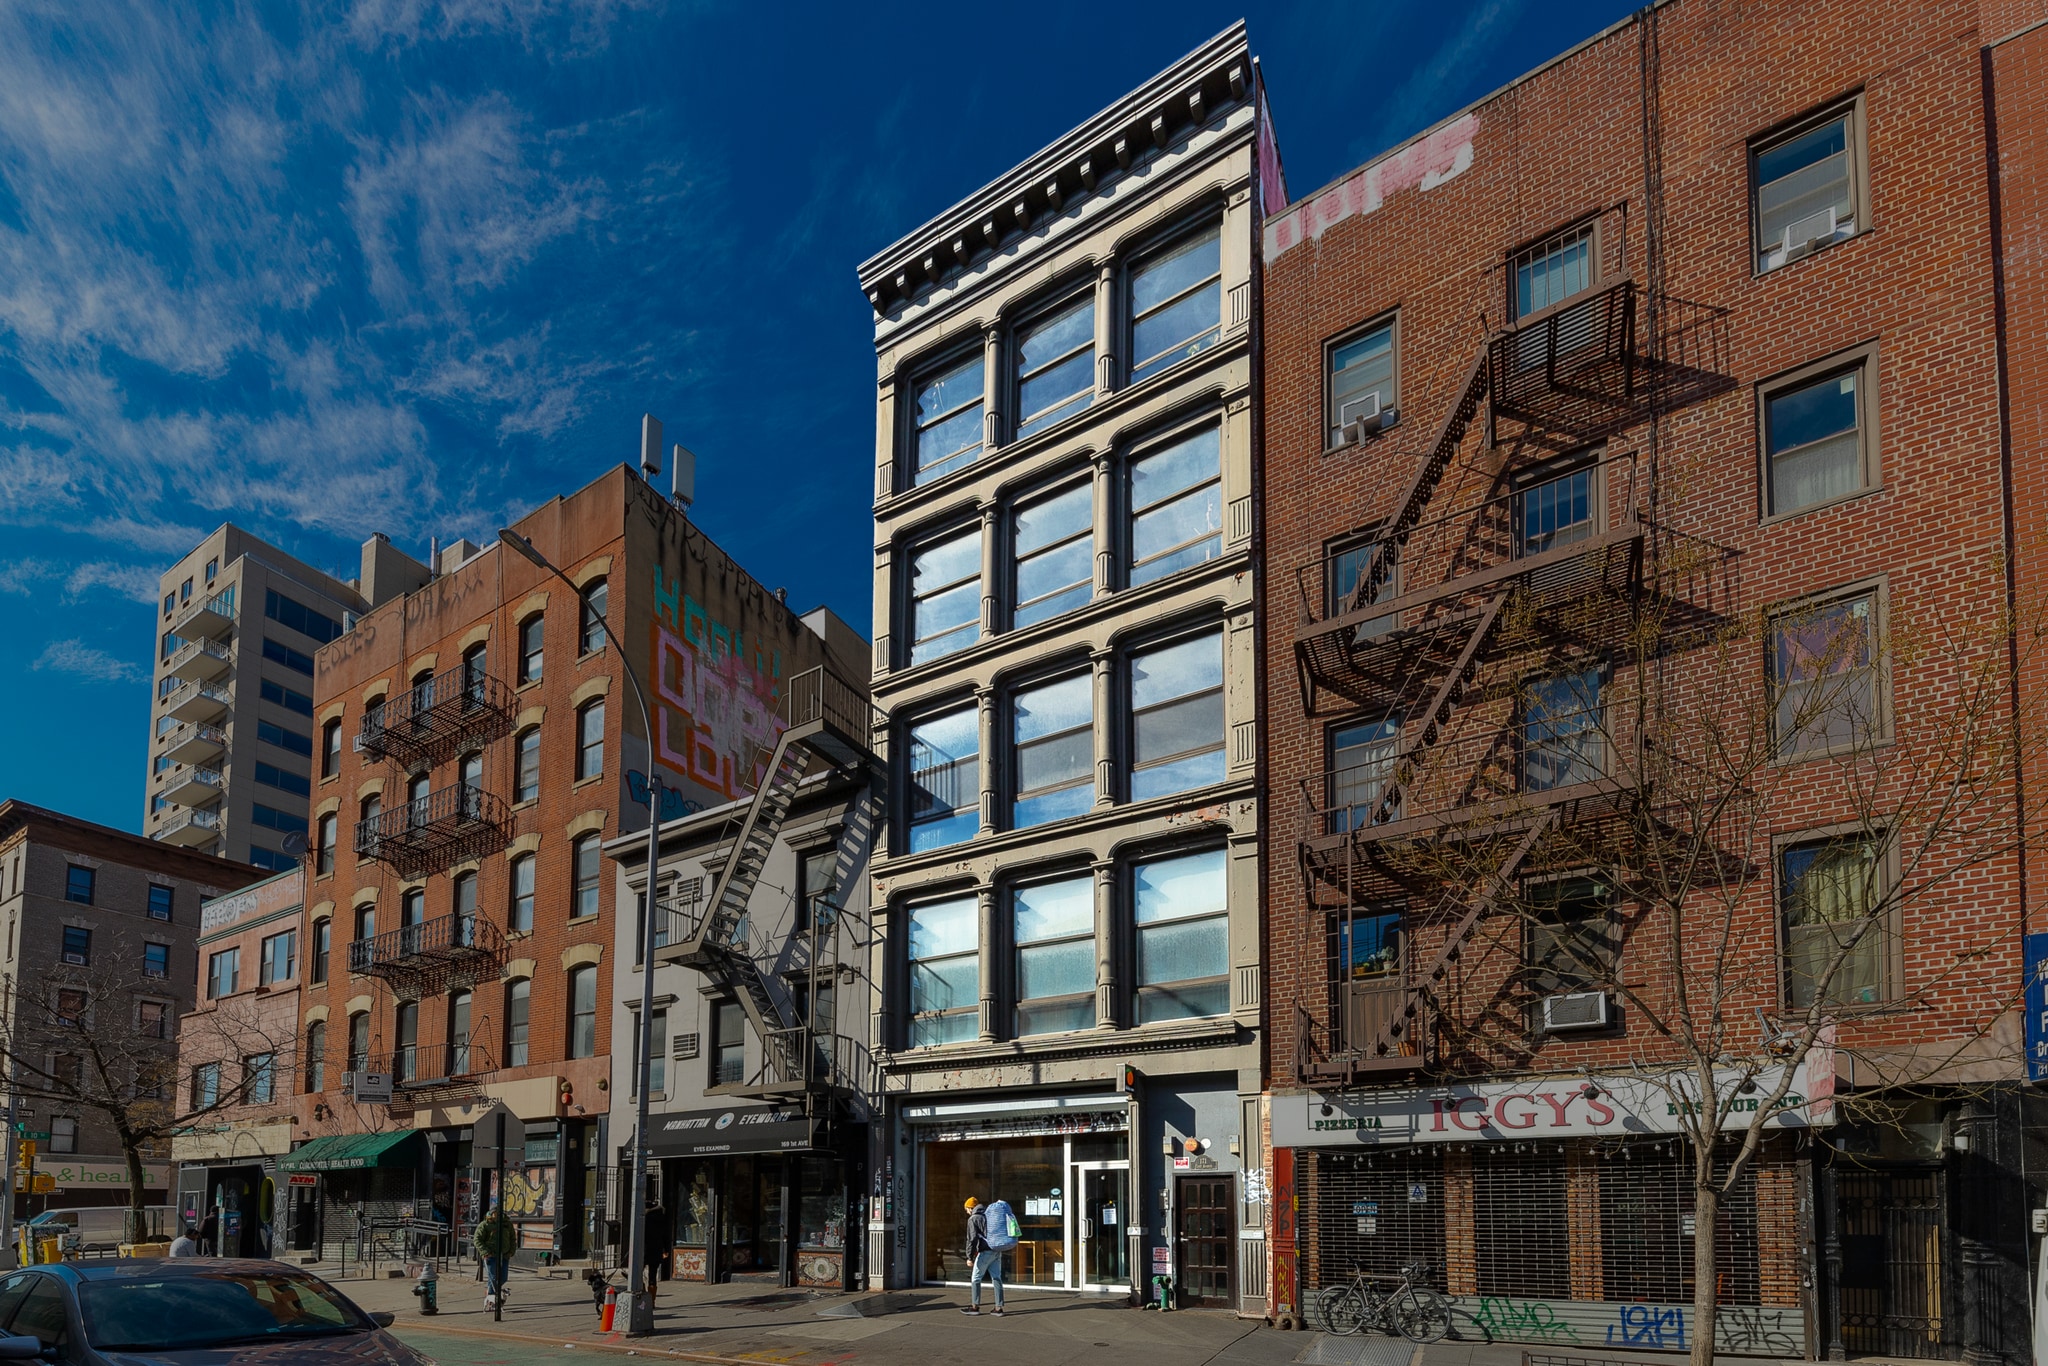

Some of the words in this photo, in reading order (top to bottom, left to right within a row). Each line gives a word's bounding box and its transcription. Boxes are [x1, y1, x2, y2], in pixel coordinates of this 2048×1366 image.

[1429, 1083, 1616, 1132] IGGY'S
[663, 1117, 712, 1131] MANHATTAN
[738, 1111, 792, 1125] EYEWORKS
[1315, 1117, 1383, 1131] PIZZERIA
[350, 1158, 364, 1167] FOOD
[80, 1165, 155, 1183] healh
[1052, 1201, 1060, 1211] A
